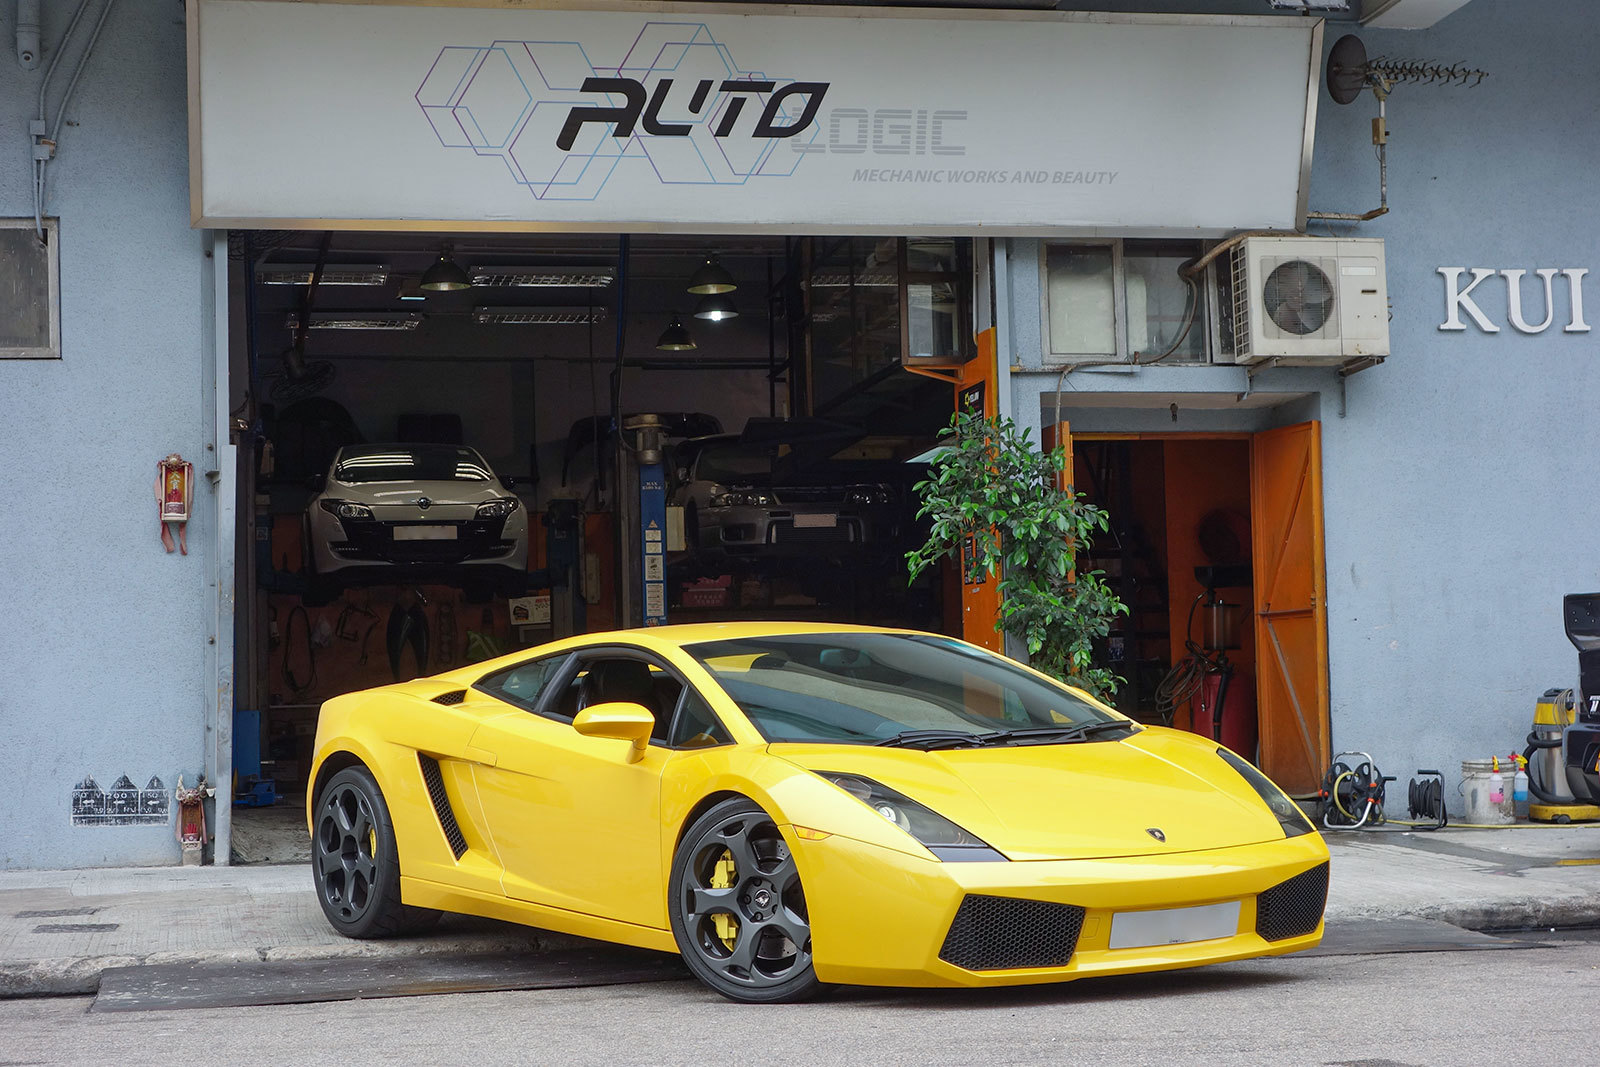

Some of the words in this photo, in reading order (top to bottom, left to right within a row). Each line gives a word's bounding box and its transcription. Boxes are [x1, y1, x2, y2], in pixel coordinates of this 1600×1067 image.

[556, 77, 831, 151] AUTO
[791, 107, 968, 155] LOGIC
[852, 169, 944, 183] MECHANIC
[947, 170, 1008, 184] WORKS
[1011, 170, 1049, 184] AND
[1051, 171, 1119, 185] BEAUTY
[1436, 267, 1592, 333] KUI
